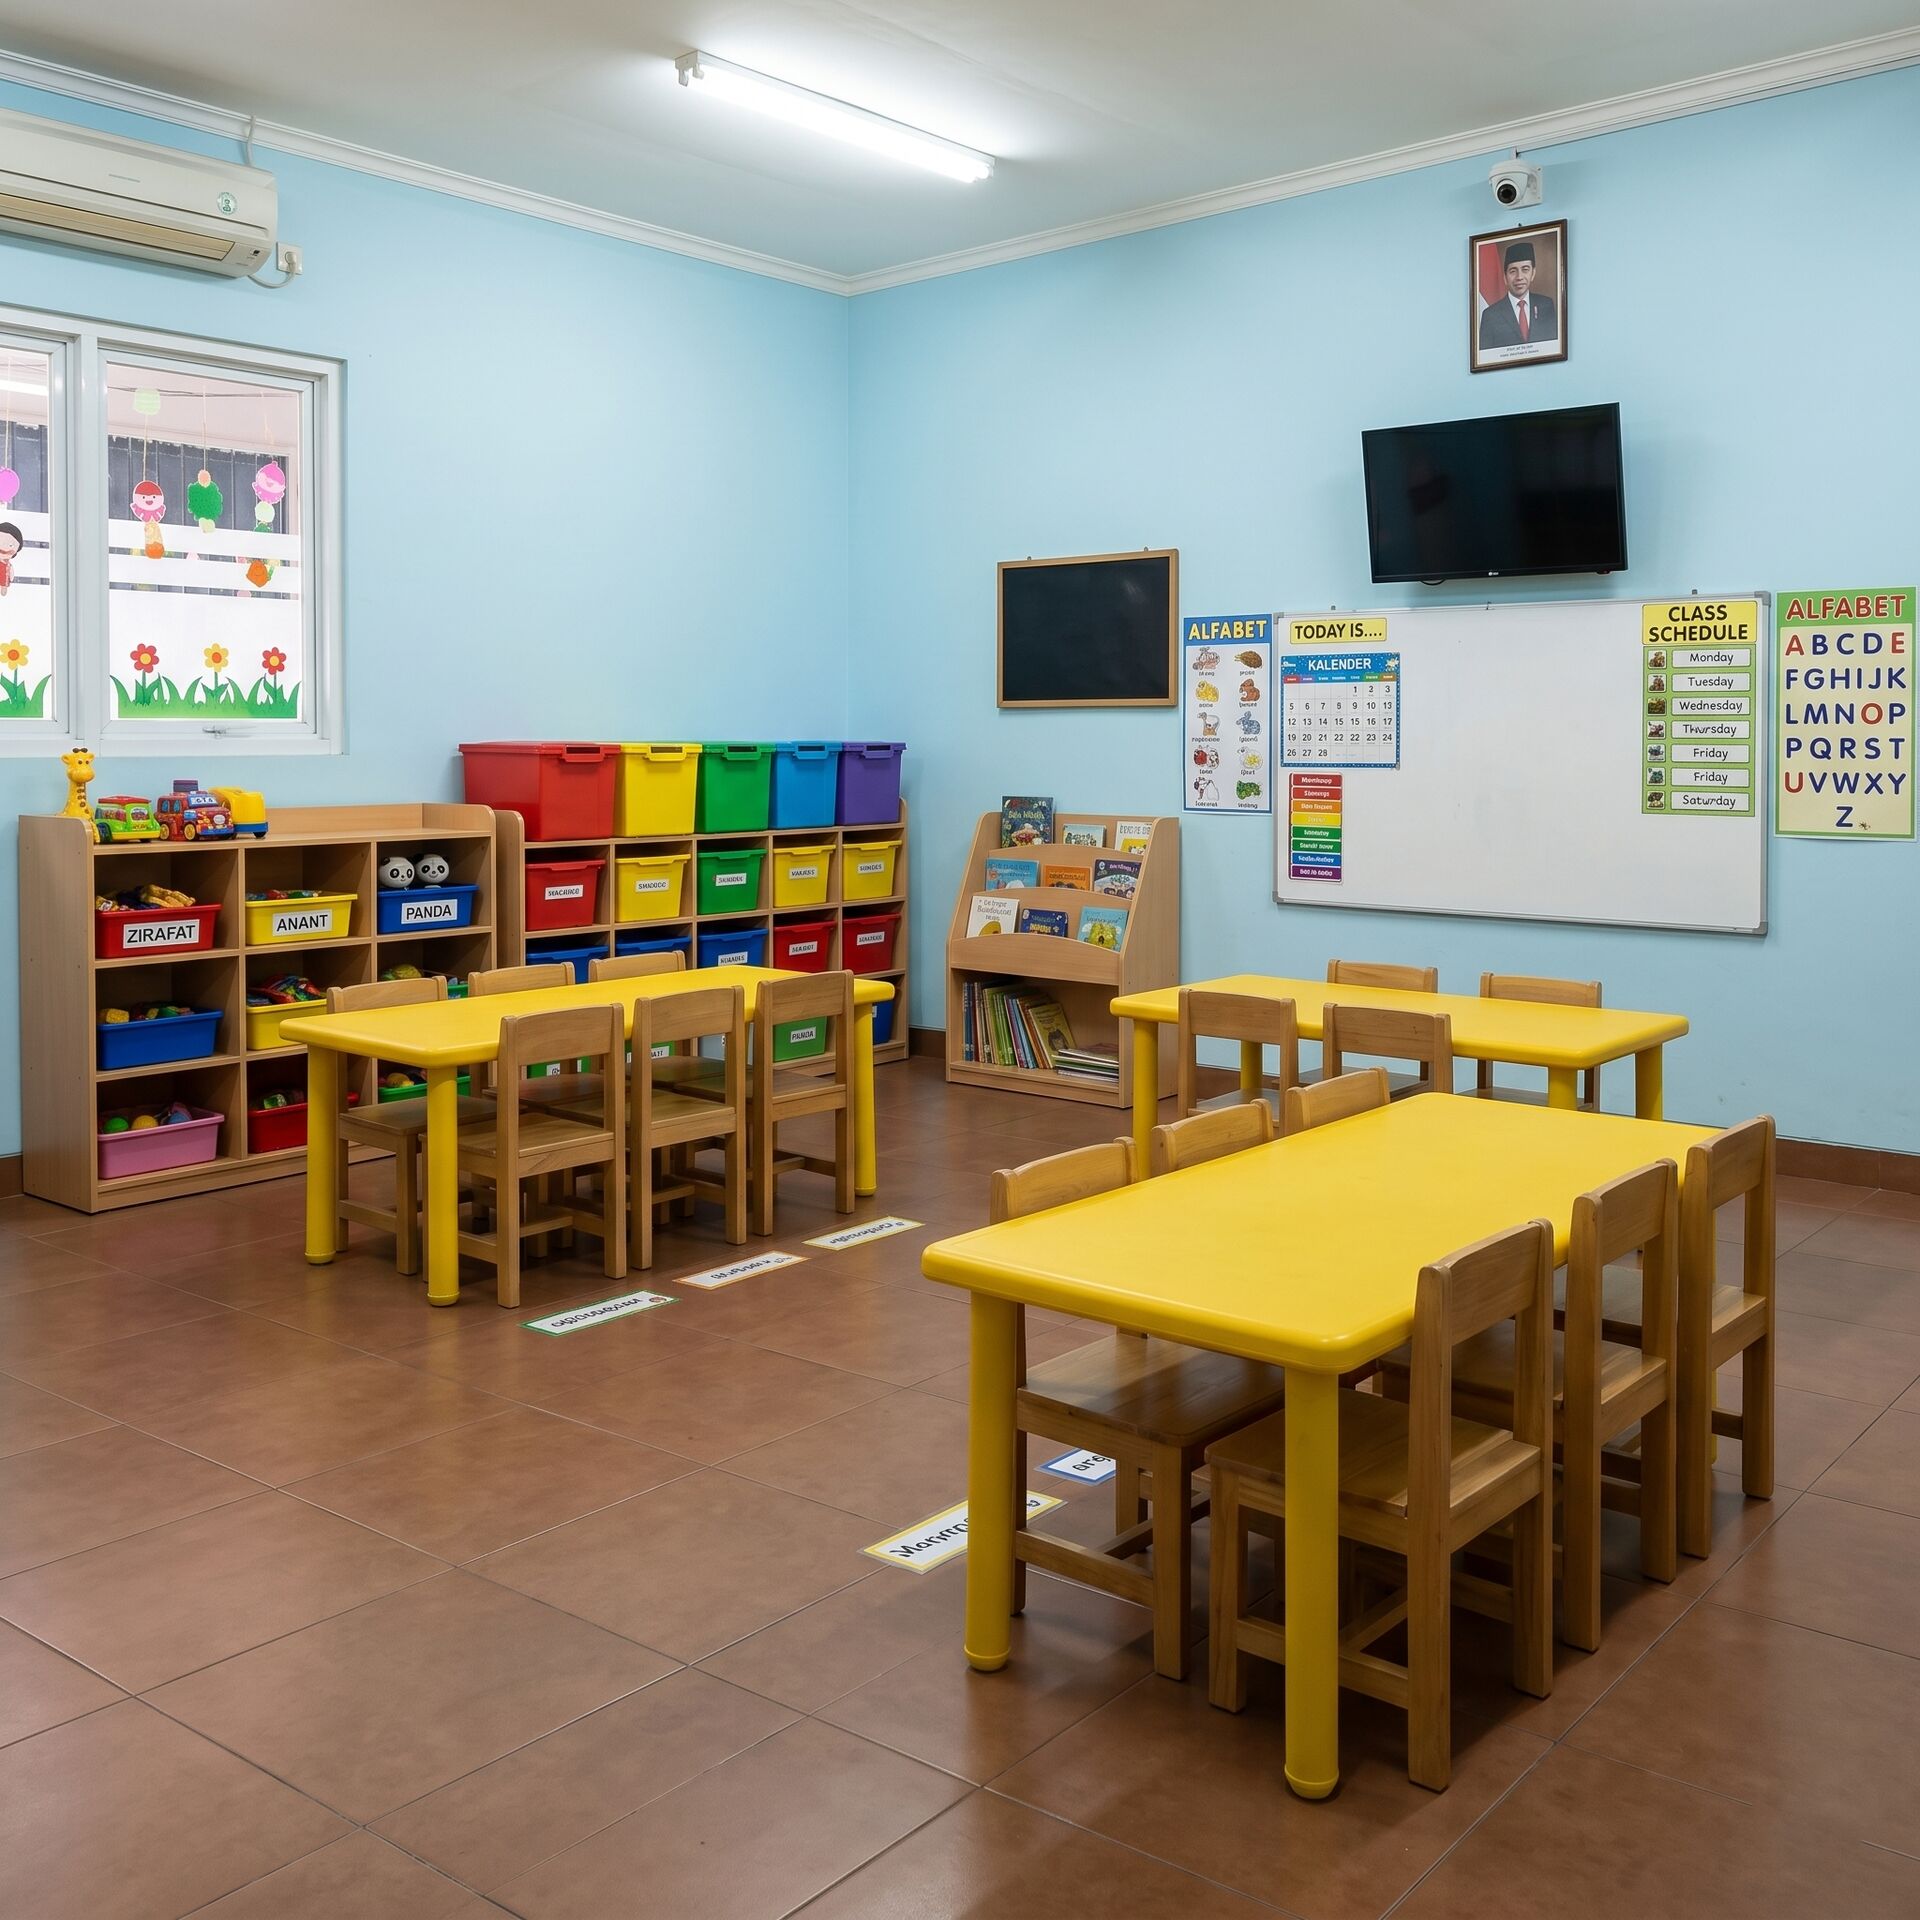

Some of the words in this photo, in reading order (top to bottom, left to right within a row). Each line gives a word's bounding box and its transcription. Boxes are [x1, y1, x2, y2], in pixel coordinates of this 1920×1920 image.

[1668, 605, 1728, 623] CLASS
[1786, 595, 1906, 620] ALFABET
[1188, 620, 1267, 640] ALFABET
[1294, 623, 1346, 640] TODAY
[1648, 624, 1748, 643] SCHEDULE
[1308, 658, 1372, 671] KALENDER
[1689, 652, 1734, 665] Monday
[1368, 685, 1374, 693] 2
[1384, 685, 1391, 693] 3
[1688, 677, 1734, 689] Tuesday
[1289, 702, 1294, 710] 5
[1320, 702, 1326, 710] 7
[1352, 701, 1358, 710] 9
[1366, 701, 1376, 710] 10
[1679, 700, 1743, 713] Wednesday
[1288, 718, 1297, 726] 12
[1303, 718, 1312, 726] 13
[1319, 718, 1328, 726] 14
[1335, 718, 1344, 726] 15
[1351, 718, 1360, 726] 15
[1367, 718, 1376, 726] 16
[1383, 718, 1392, 726] 17
[1287, 733, 1297, 742] 19
[1302, 733, 1312, 742] 20
[1318, 733, 1328, 742] 21
[1334, 733, 1344, 742] 22
[1350, 733, 1360, 742] 22
[1366, 733, 1376, 742] 23
[1382, 733, 1392, 742] 24
[1287, 748, 1297, 757] 26
[1302, 748, 1312, 757] 27
[1318, 748, 1328, 757] 28
[1693, 748, 1729, 761] Friday
[1693, 772, 1729, 785] Friday
[1835, 806, 1854, 828] Z
[405, 903, 452, 920] PANDA
[275, 913, 329, 932] ANANT
[127, 925, 196, 943] ZIRAFAT
